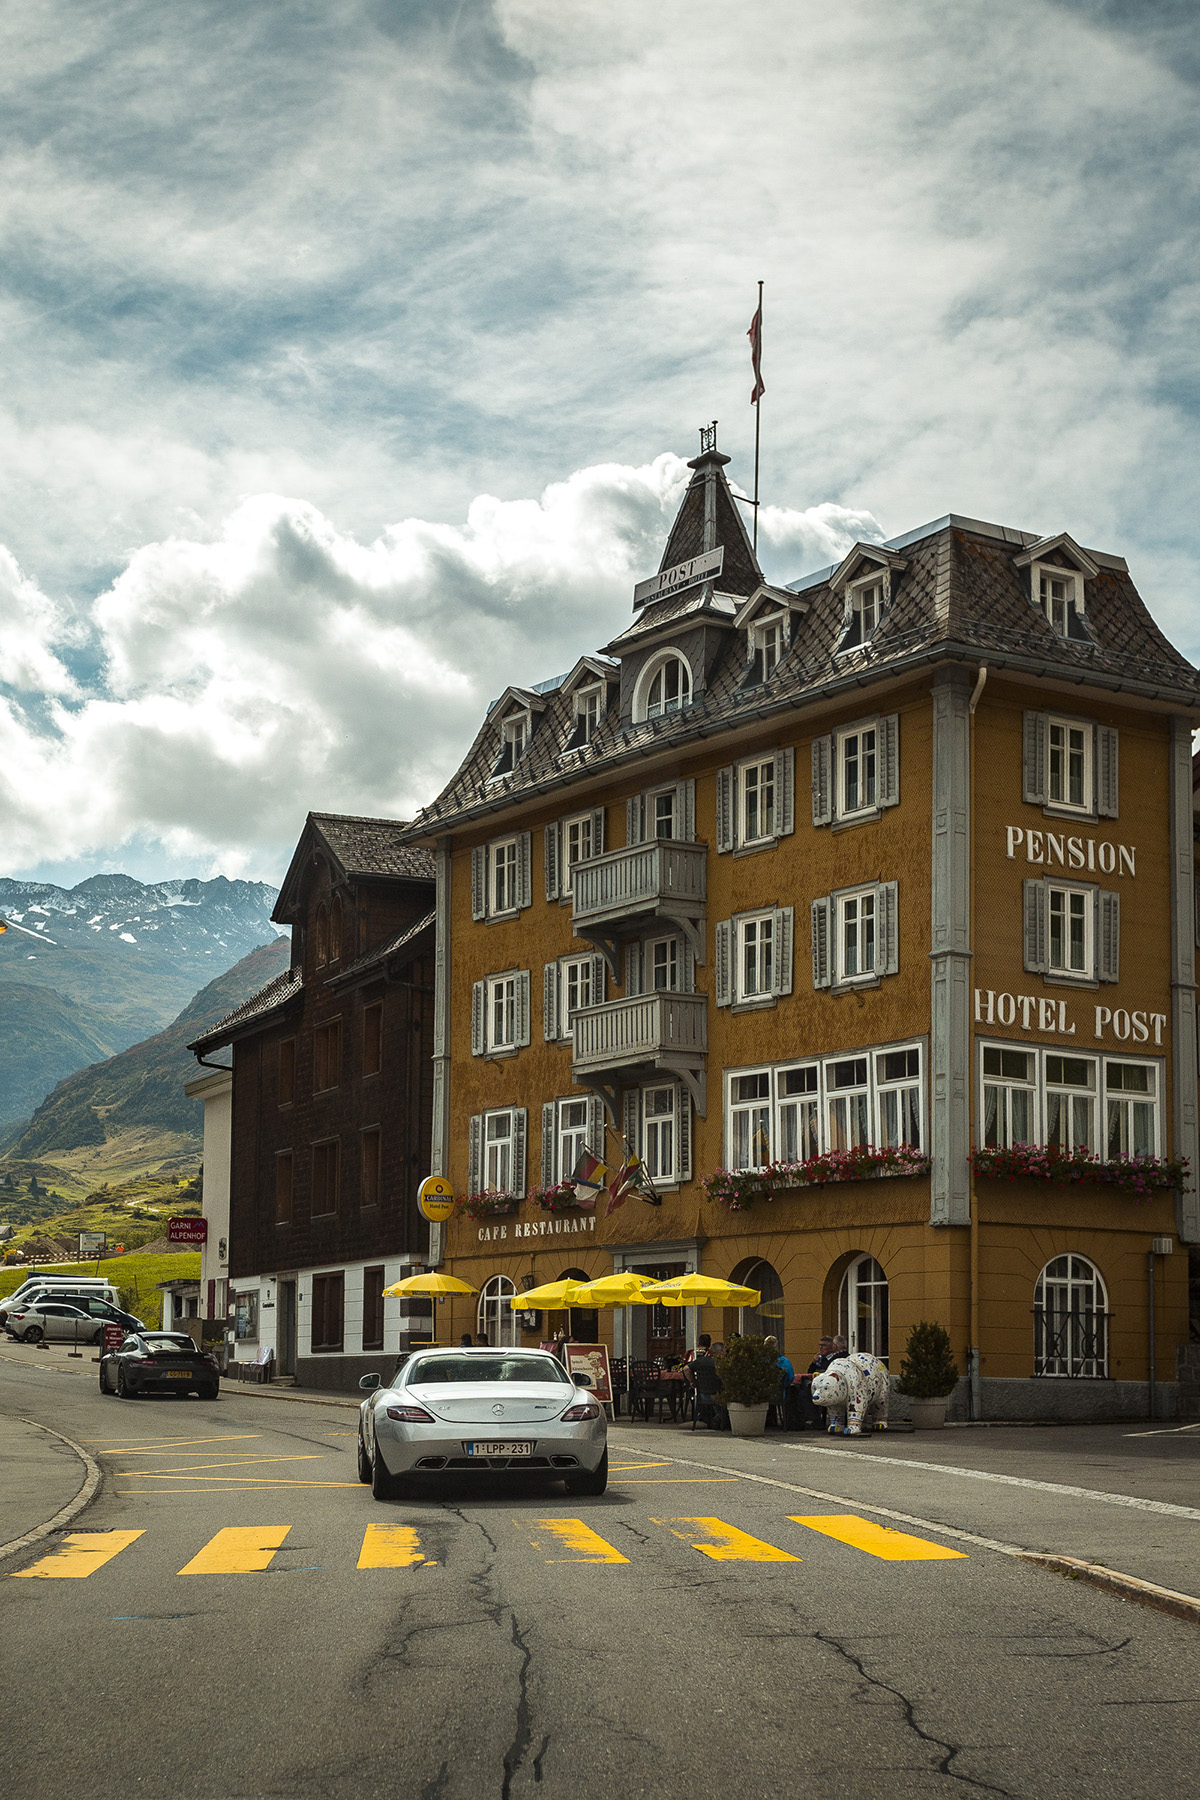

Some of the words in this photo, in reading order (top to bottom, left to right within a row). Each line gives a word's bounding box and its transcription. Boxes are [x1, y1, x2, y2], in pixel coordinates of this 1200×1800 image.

[659, 560, 696, 590] POST
[1005, 825, 1136, 878] PENSION
[974, 988, 1076, 1036] HOTEL
[1093, 1005, 1167, 1046] POST
[170, 1222, 191, 1230] GARNI
[170, 1232, 206, 1240] ALPENHOF
[478, 1225, 507, 1241] CAFE
[515, 1217, 596, 1238] RESTAURANT
